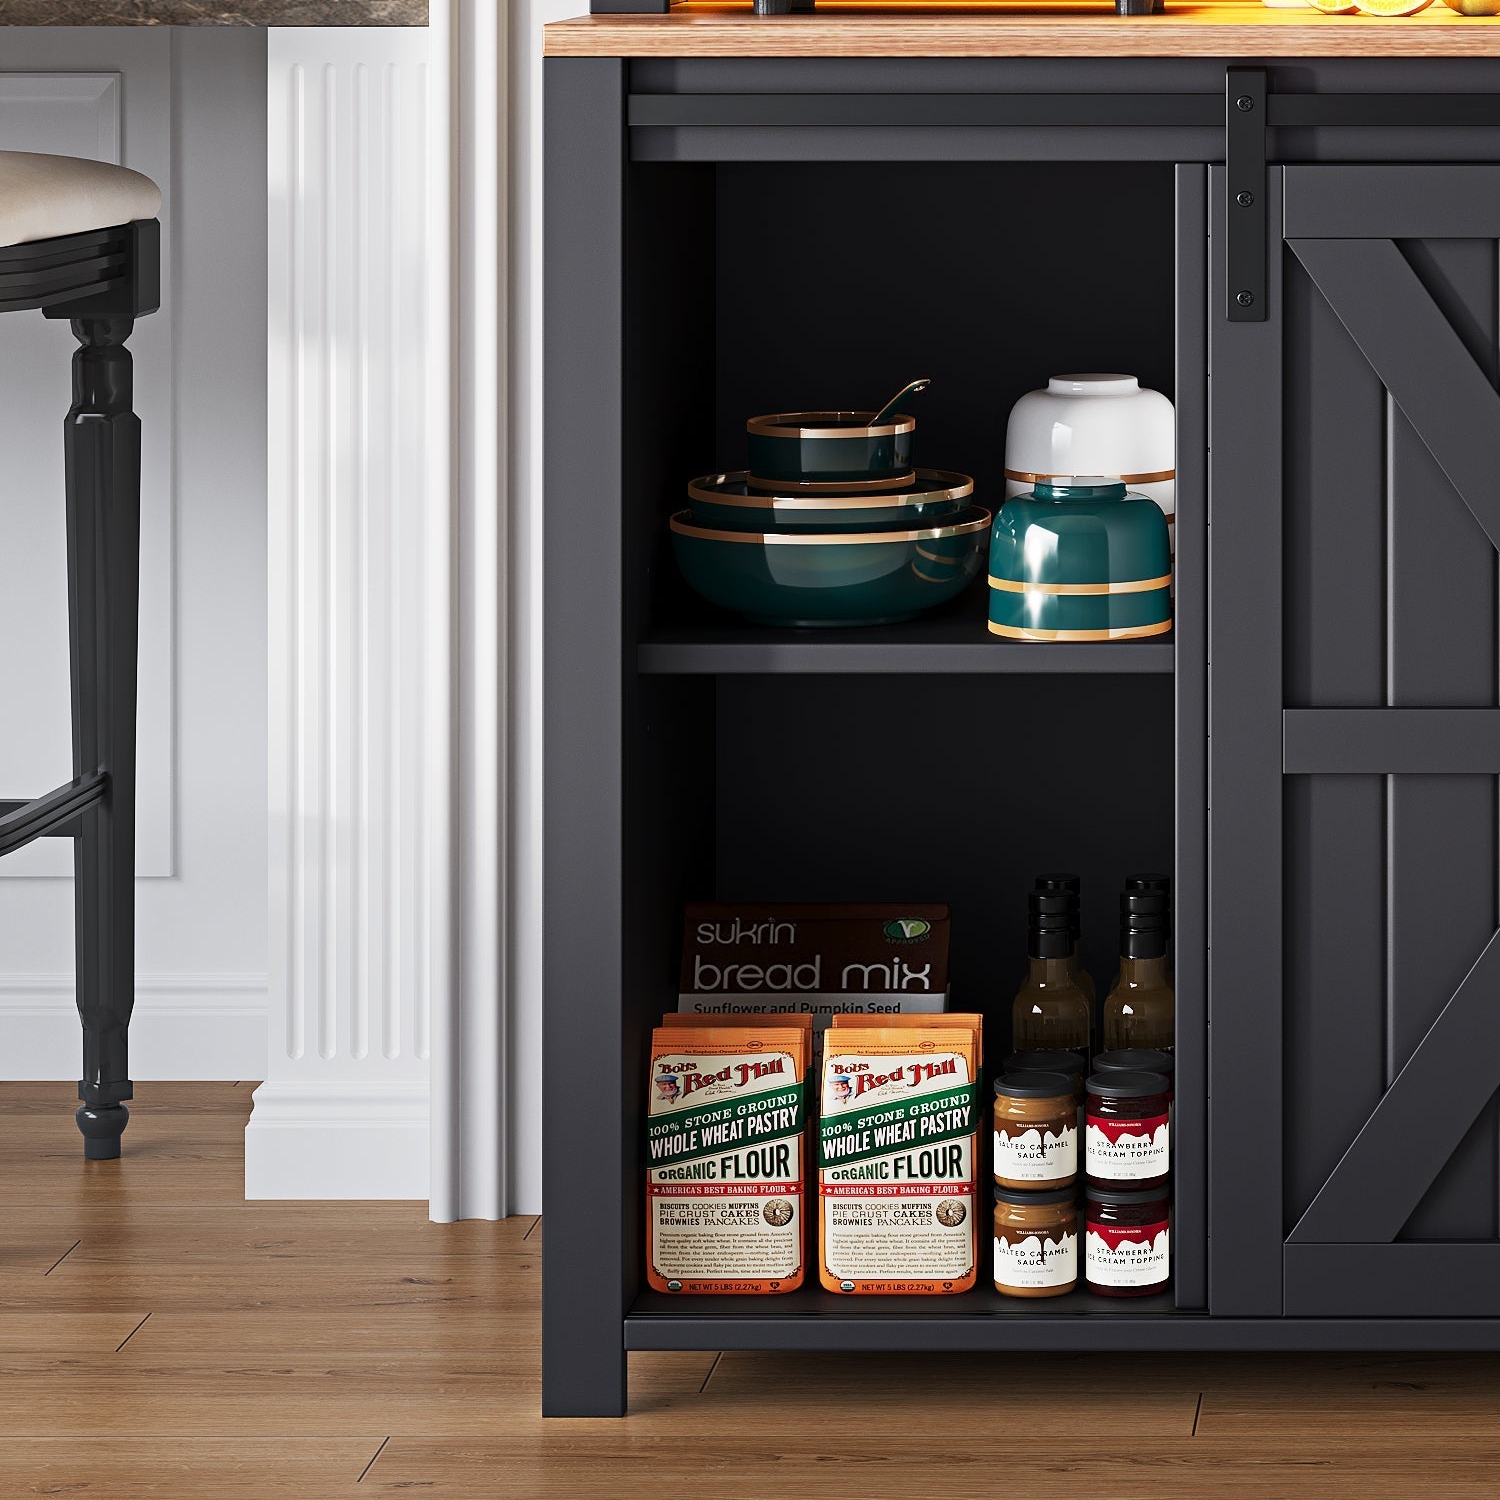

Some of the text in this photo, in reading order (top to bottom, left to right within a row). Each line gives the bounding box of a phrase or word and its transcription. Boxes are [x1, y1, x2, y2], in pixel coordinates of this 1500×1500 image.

[697, 918, 795, 944] sukrin
[693, 954, 931, 991] bread mix
[694, 1002, 901, 1014] Sunflower and Pumpkin Seed
[681, 1065, 733, 1099] Red
[734, 1057, 785, 1087] Mill
[854, 1057, 958, 1099] Red Mill
[649, 1093, 798, 1137] 100% STONE GROUND
[821, 1093, 970, 1137] 100% STONE GROUND
[650, 1104, 799, 1160] WHOLE WHEAT PASTRY
[822, 1105, 971, 1160] WHOLE WHEAT PASTRY
[998, 1141, 1069, 1150] SALTED CARAMEL
[1096, 1141, 1153, 1149] STRAWBERRY
[1097, 1150, 1126, 1158] CREAM
[1130, 1146, 1164, 1158] TOPPING
[658, 1144, 791, 1180] ORGANIC FLOUR
[831, 1144, 964, 1180] ORGANIC FLOUR
[660, 1185, 787, 1195] AMERICA'S BEST BAKING FLOUR
[833, 1185, 960, 1195] AMERICA'S BEST BAKING FLOUR
[660, 1210, 760, 1218] PIE CRUST CAKES
[832, 1210, 933, 1218] PIE CRUST CAKES
[660, 1218, 760, 1226] BROWNIES PANCAKES
[832, 1218, 933, 1226] BROWNIES PANCAKES
[998, 1248, 1069, 1257] SALTED CARAMEL
[1096, 1248, 1153, 1256] STRAWBERRY
[1097, 1257, 1126, 1265] CREAM
[1130, 1253, 1164, 1265] TOPPING
[735, 1283, 761, 1291] (2.27kg)
[907, 1283, 934, 1291] (2.27kg)
